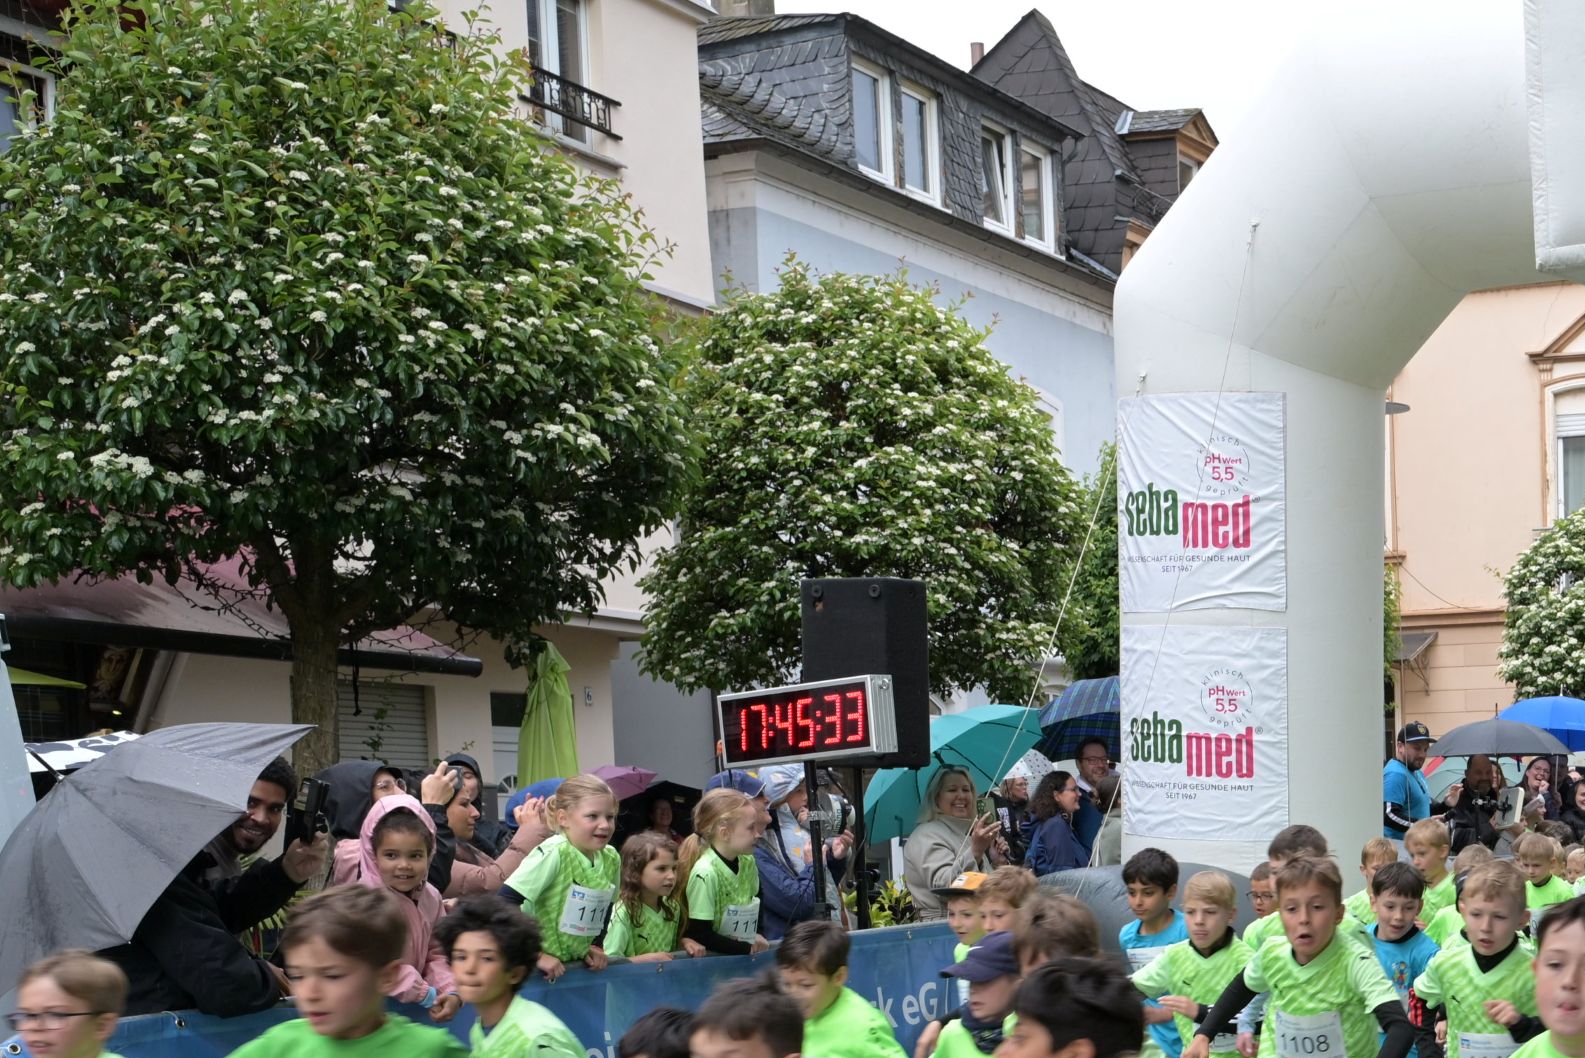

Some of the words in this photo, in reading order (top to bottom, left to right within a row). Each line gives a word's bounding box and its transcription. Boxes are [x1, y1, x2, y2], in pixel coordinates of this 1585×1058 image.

[1211, 466, 1235, 482] 5,5
[1205, 476, 1249, 497] geprüft
[1168, 554, 1184, 563] FÜR
[1185, 554, 1227, 563] GESUNDE
[1227, 555, 1251, 563] HAUT
[1161, 565, 1177, 573] SEIT
[1177, 565, 1193, 573] 1967
[1201, 667, 1244, 686] klinisch
[1215, 698, 1238, 714] 5,5
[740, 690, 864, 752] 17:45:33
[1210, 708, 1252, 728] geprüft
[1172, 781, 1188, 790] FÜR
[1188, 782, 1229, 791] GESUNDE
[1230, 784, 1254, 792] HAUT
[1280, 1033, 1330, 1054] 1108
